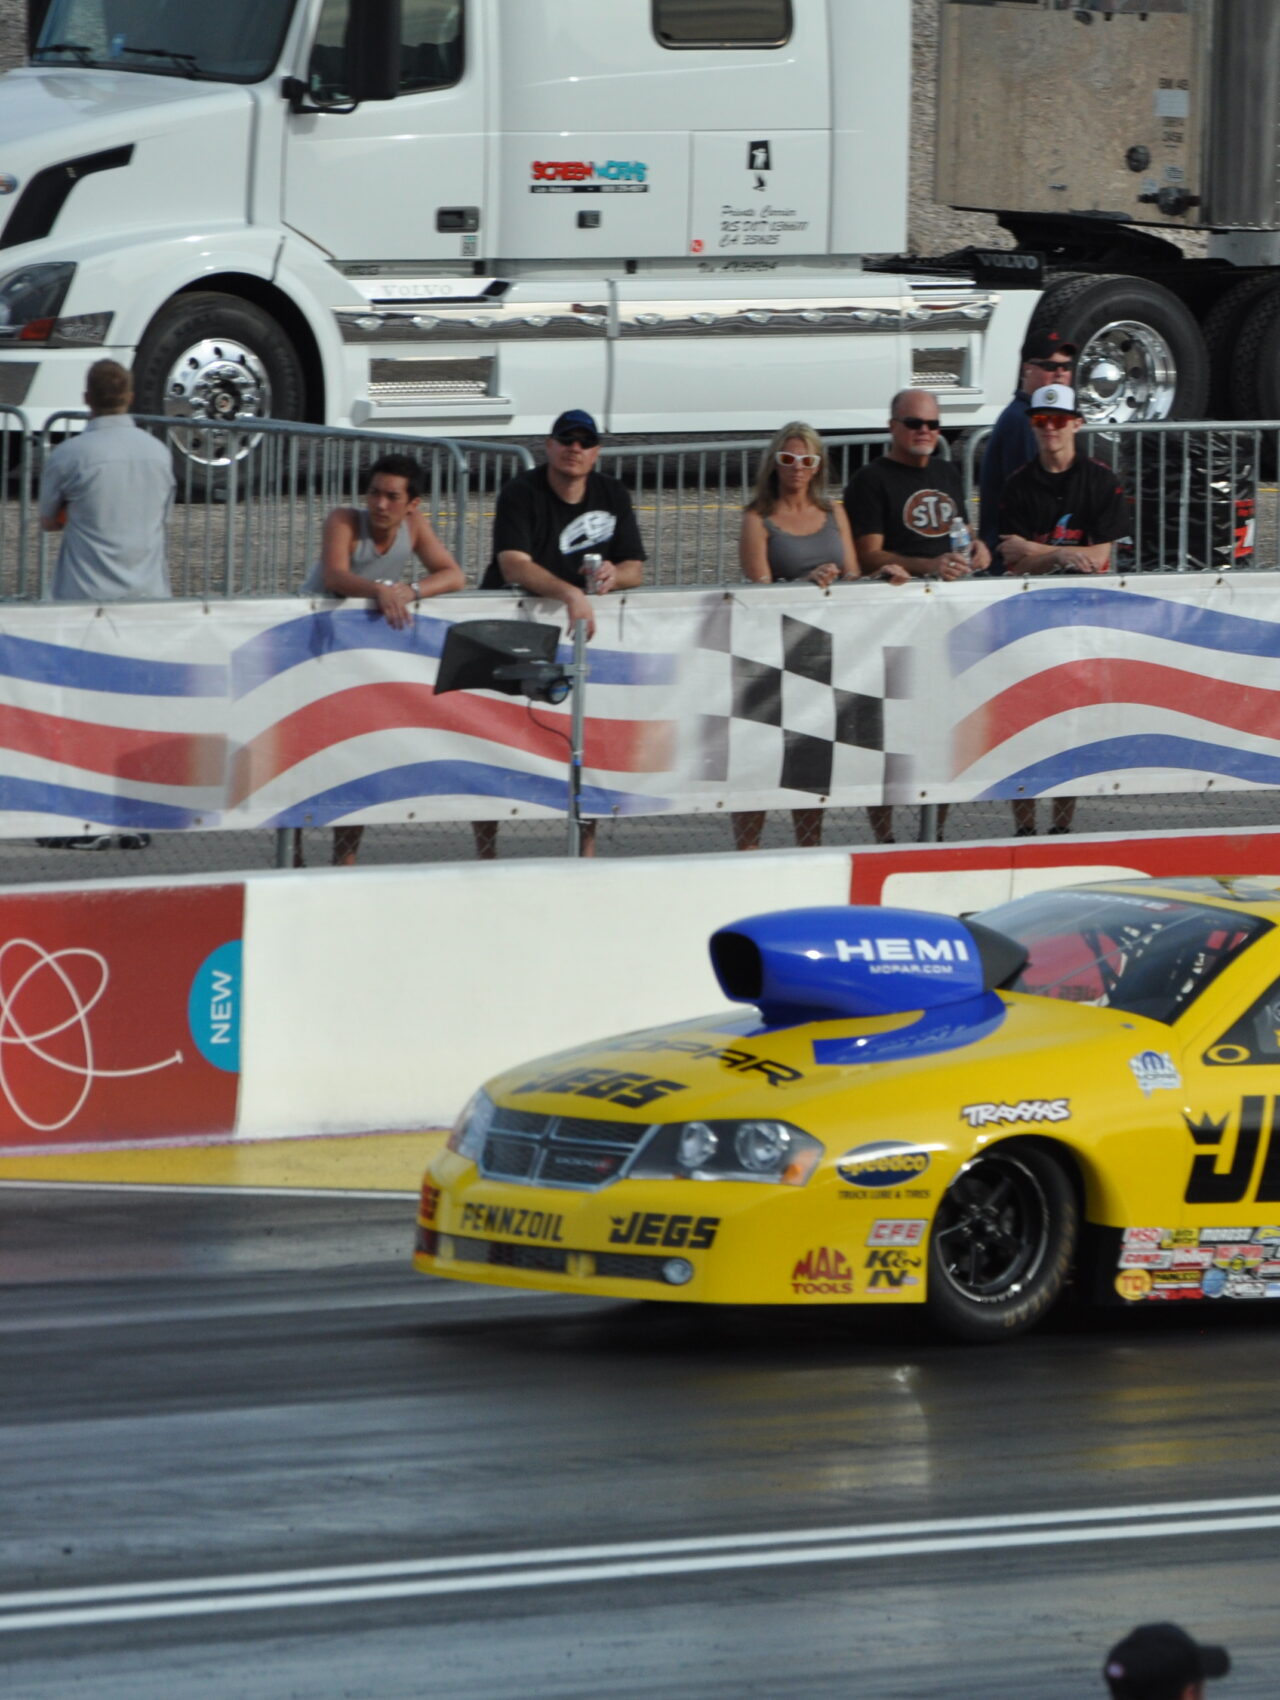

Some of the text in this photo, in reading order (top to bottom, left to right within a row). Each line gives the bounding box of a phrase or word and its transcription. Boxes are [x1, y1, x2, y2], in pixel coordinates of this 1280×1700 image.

[977, 253, 1039, 270] VOLVO
[382, 284, 452, 296] VOLVO
[911, 496, 953, 528] STP
[834, 938, 970, 962] HEMI
[869, 964, 953, 974] MOPAR.COM
[210, 970, 233, 1045] NEW
[509, 1067, 690, 1109] JEGS
[961, 1098, 1071, 1127] TRAXXAS
[460, 1202, 564, 1242] PENNZOIL
[608, 1212, 721, 1249] JEGS
[791, 1246, 853, 1281] MAC
[791, 1282, 853, 1295] TOOLS
